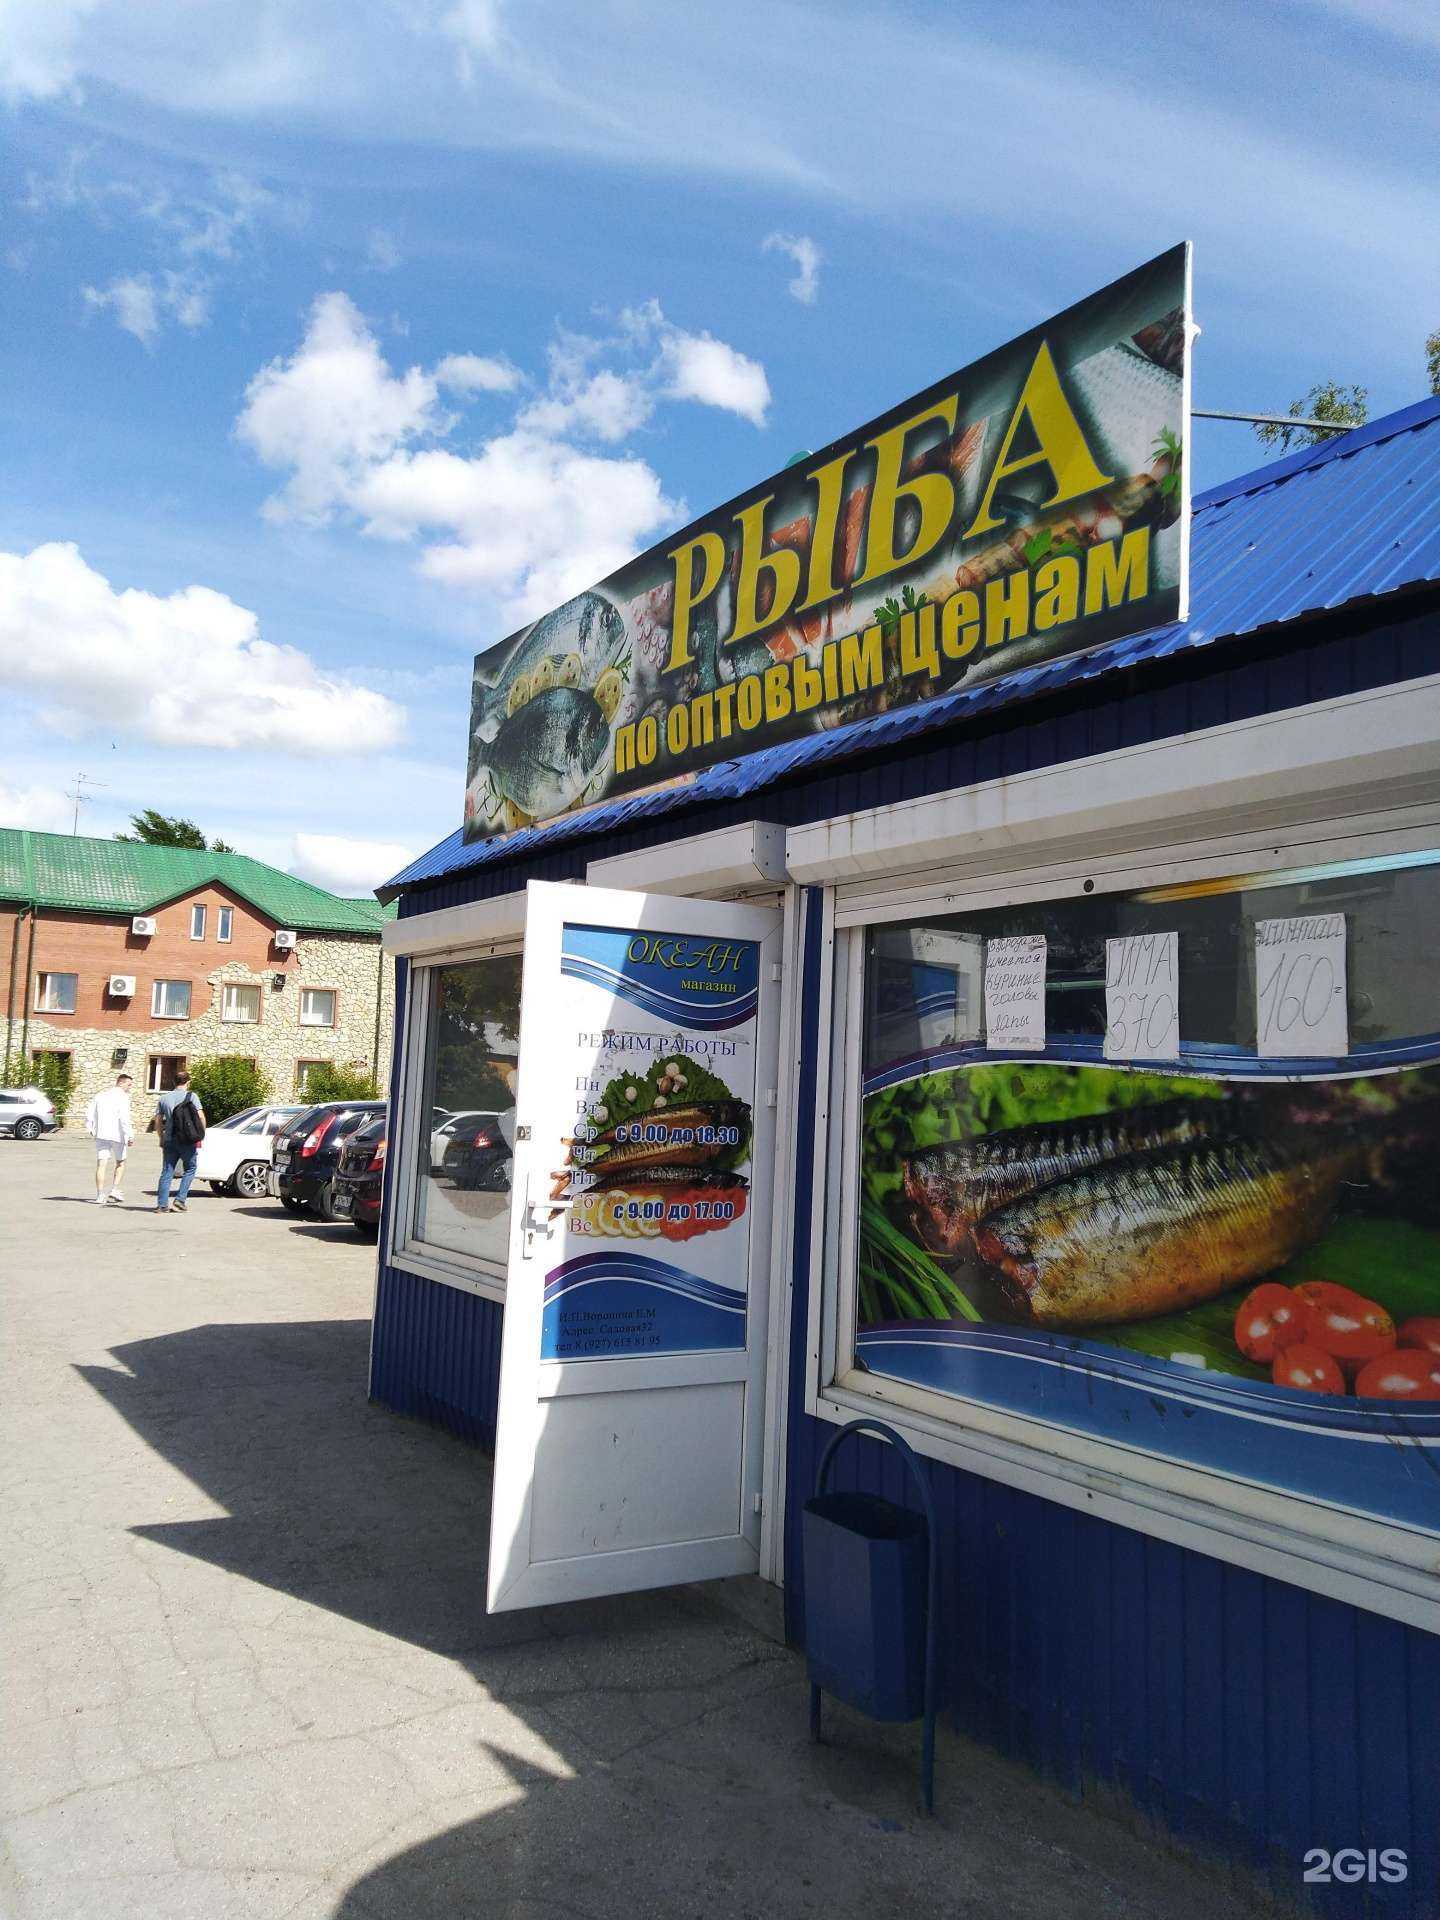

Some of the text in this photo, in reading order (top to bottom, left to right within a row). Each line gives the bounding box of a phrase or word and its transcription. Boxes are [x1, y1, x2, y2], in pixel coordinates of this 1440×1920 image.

[662, 339, 1115, 675] РЫБА
[615, 525, 1151, 774] по оптовым ценам
[628, 937, 748, 973] ОКЕАН
[681, 979, 737, 993] магазин
[577, 1032, 737, 1055] РЕЖИМ РАБОТЫ
[575, 1076, 600, 1091] Пн
[576, 1100, 597, 1114] Вт
[574, 1123, 597, 1142] Ср
[616, 1125, 739, 1144] с 9.00 до 18.30
[572, 1146, 596, 1161] Чт
[571, 1170, 595, 1185] Пт
[613, 1202, 735, 1220] с 9.00 до 17.00
[569, 1218, 592, 1232] Вс
